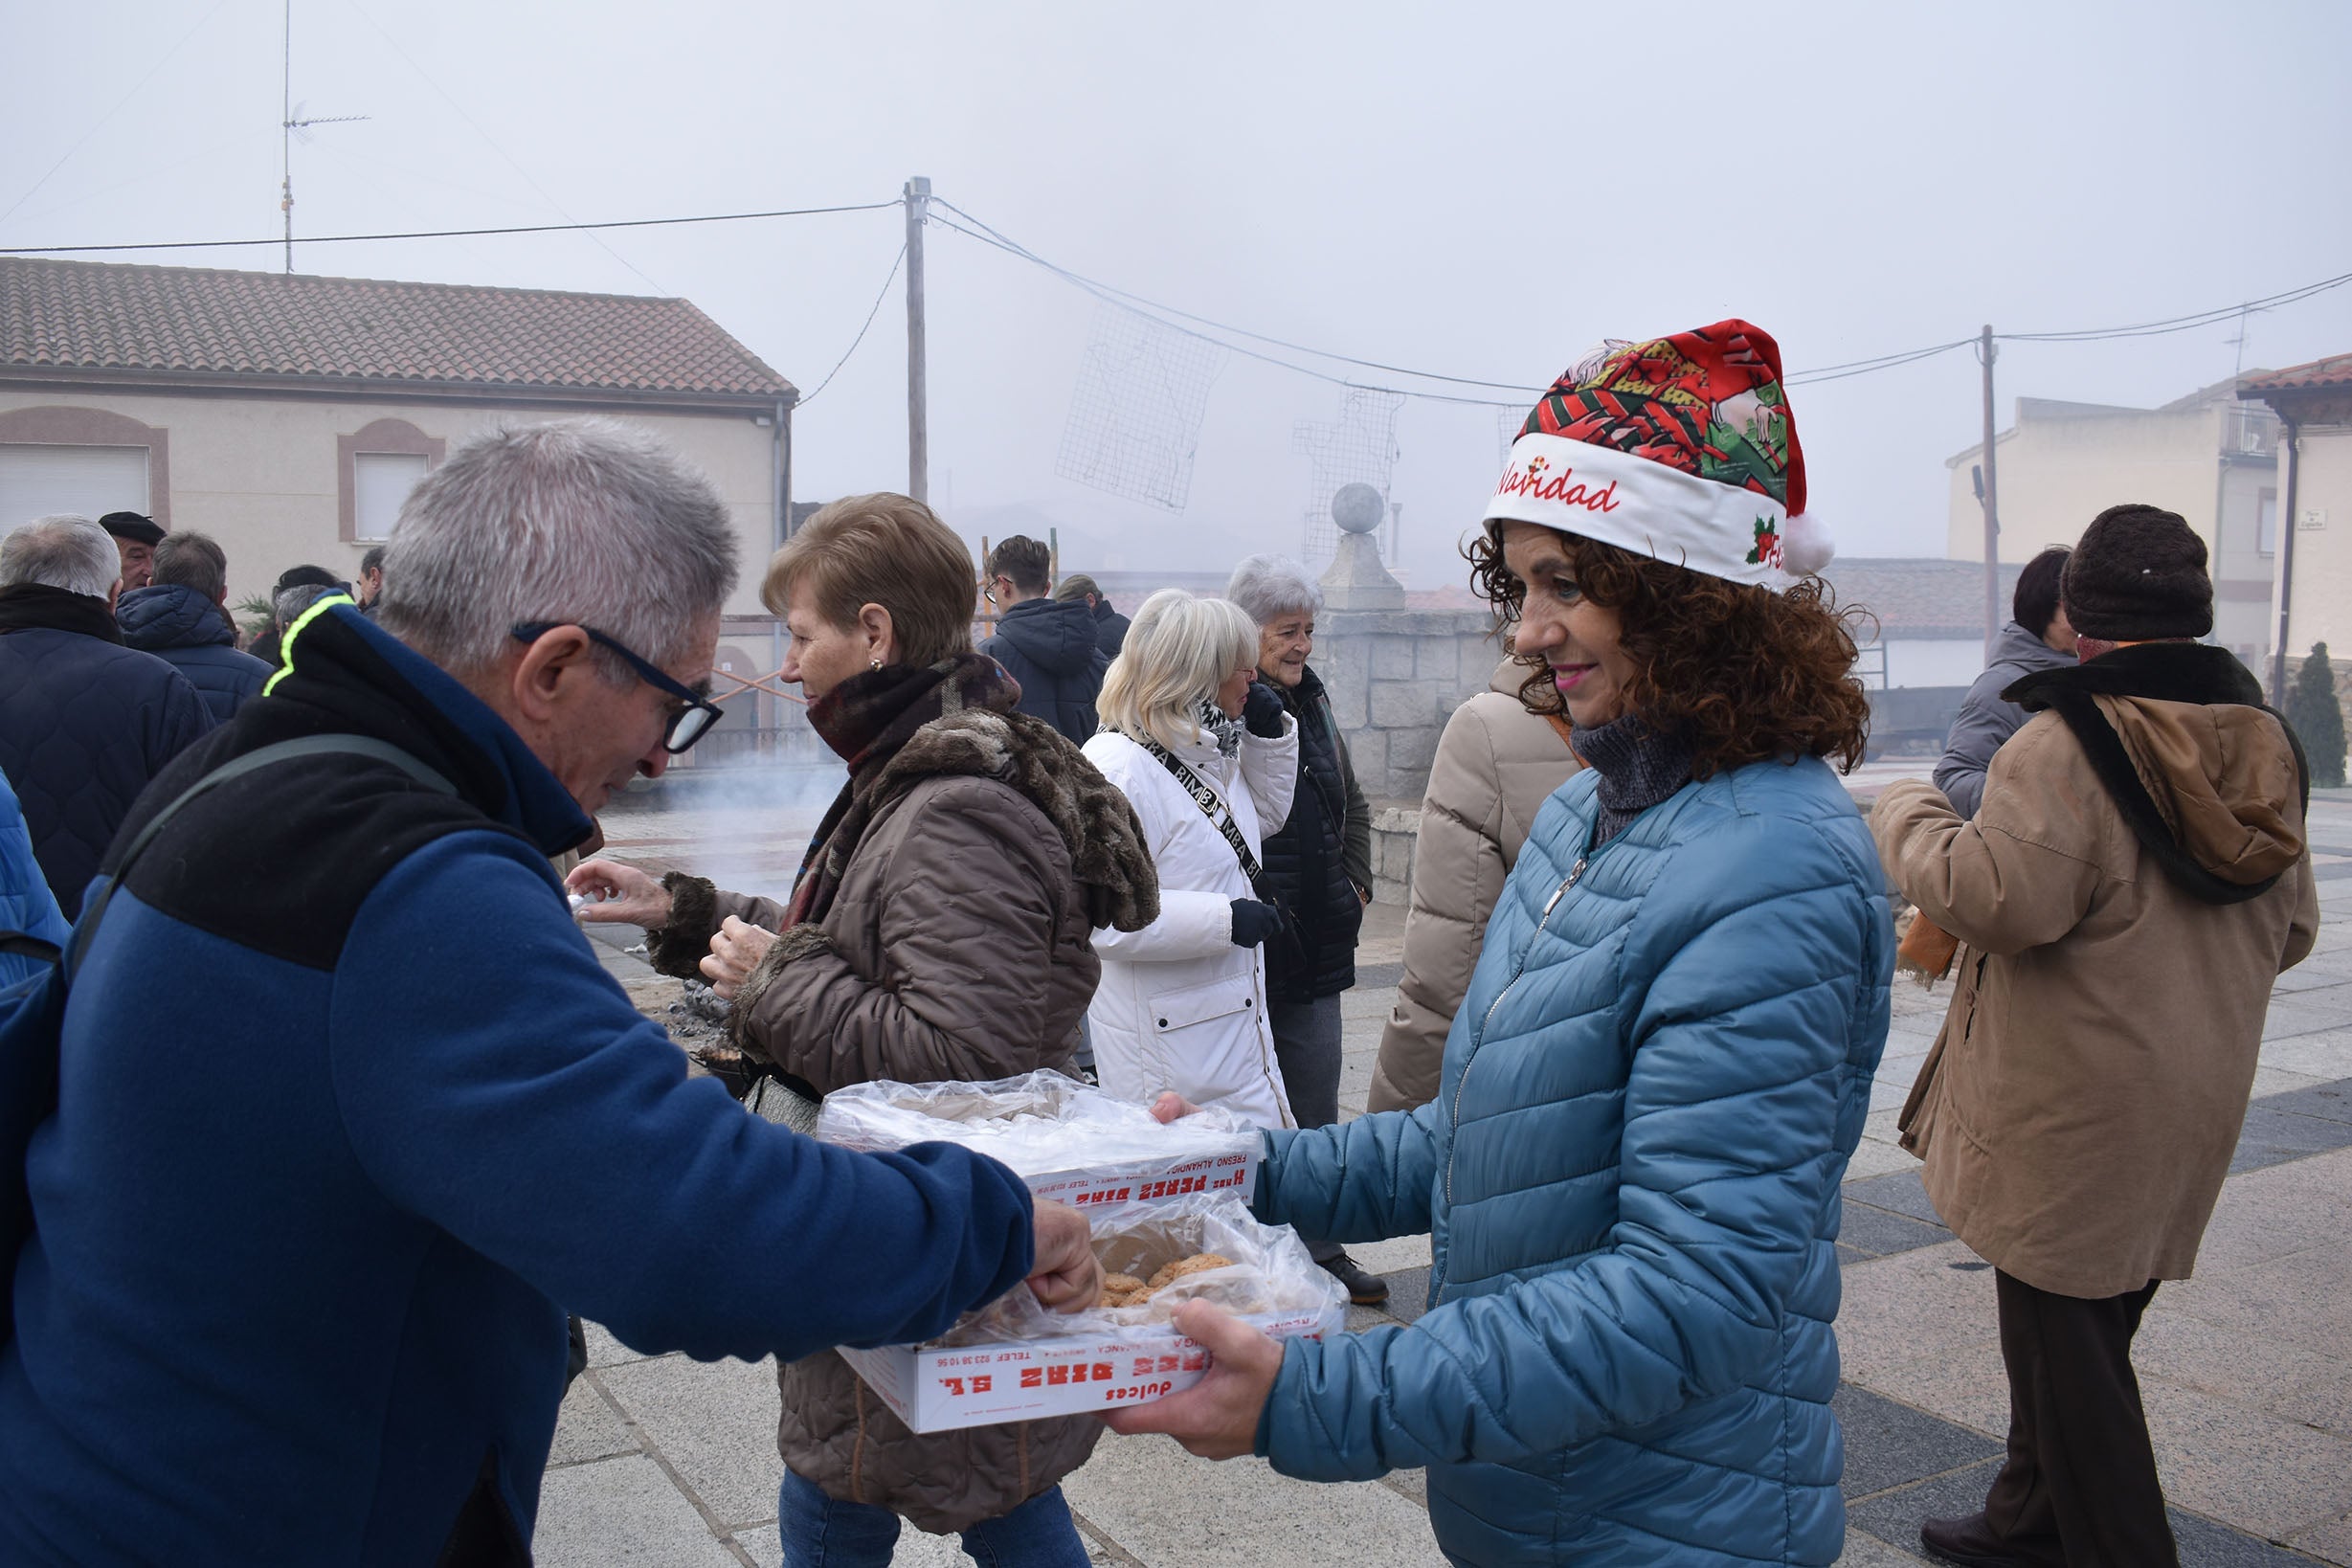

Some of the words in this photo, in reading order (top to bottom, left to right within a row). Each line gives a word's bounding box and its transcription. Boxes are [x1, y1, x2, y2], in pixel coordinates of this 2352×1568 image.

[1493, 459, 1620, 513] Navidad
[1175, 766, 1219, 817] BIMBA
[1222, 818, 1246, 860] MBA
[1247, 861, 1263, 881] BI
[1217, 1154, 1247, 1167] FRESNO
[1075, 1187, 1131, 1205] DIAZ
[1138, 1175, 1207, 1200] PEREZ
[937, 1358, 949, 1368] 56
[950, 1357, 960, 1366] 10
[962, 1356, 974, 1365] 38
[974, 1355, 991, 1364] 923
[1020, 1362, 1114, 1388] DIAZ
[1105, 1380, 1172, 1401] dulces
